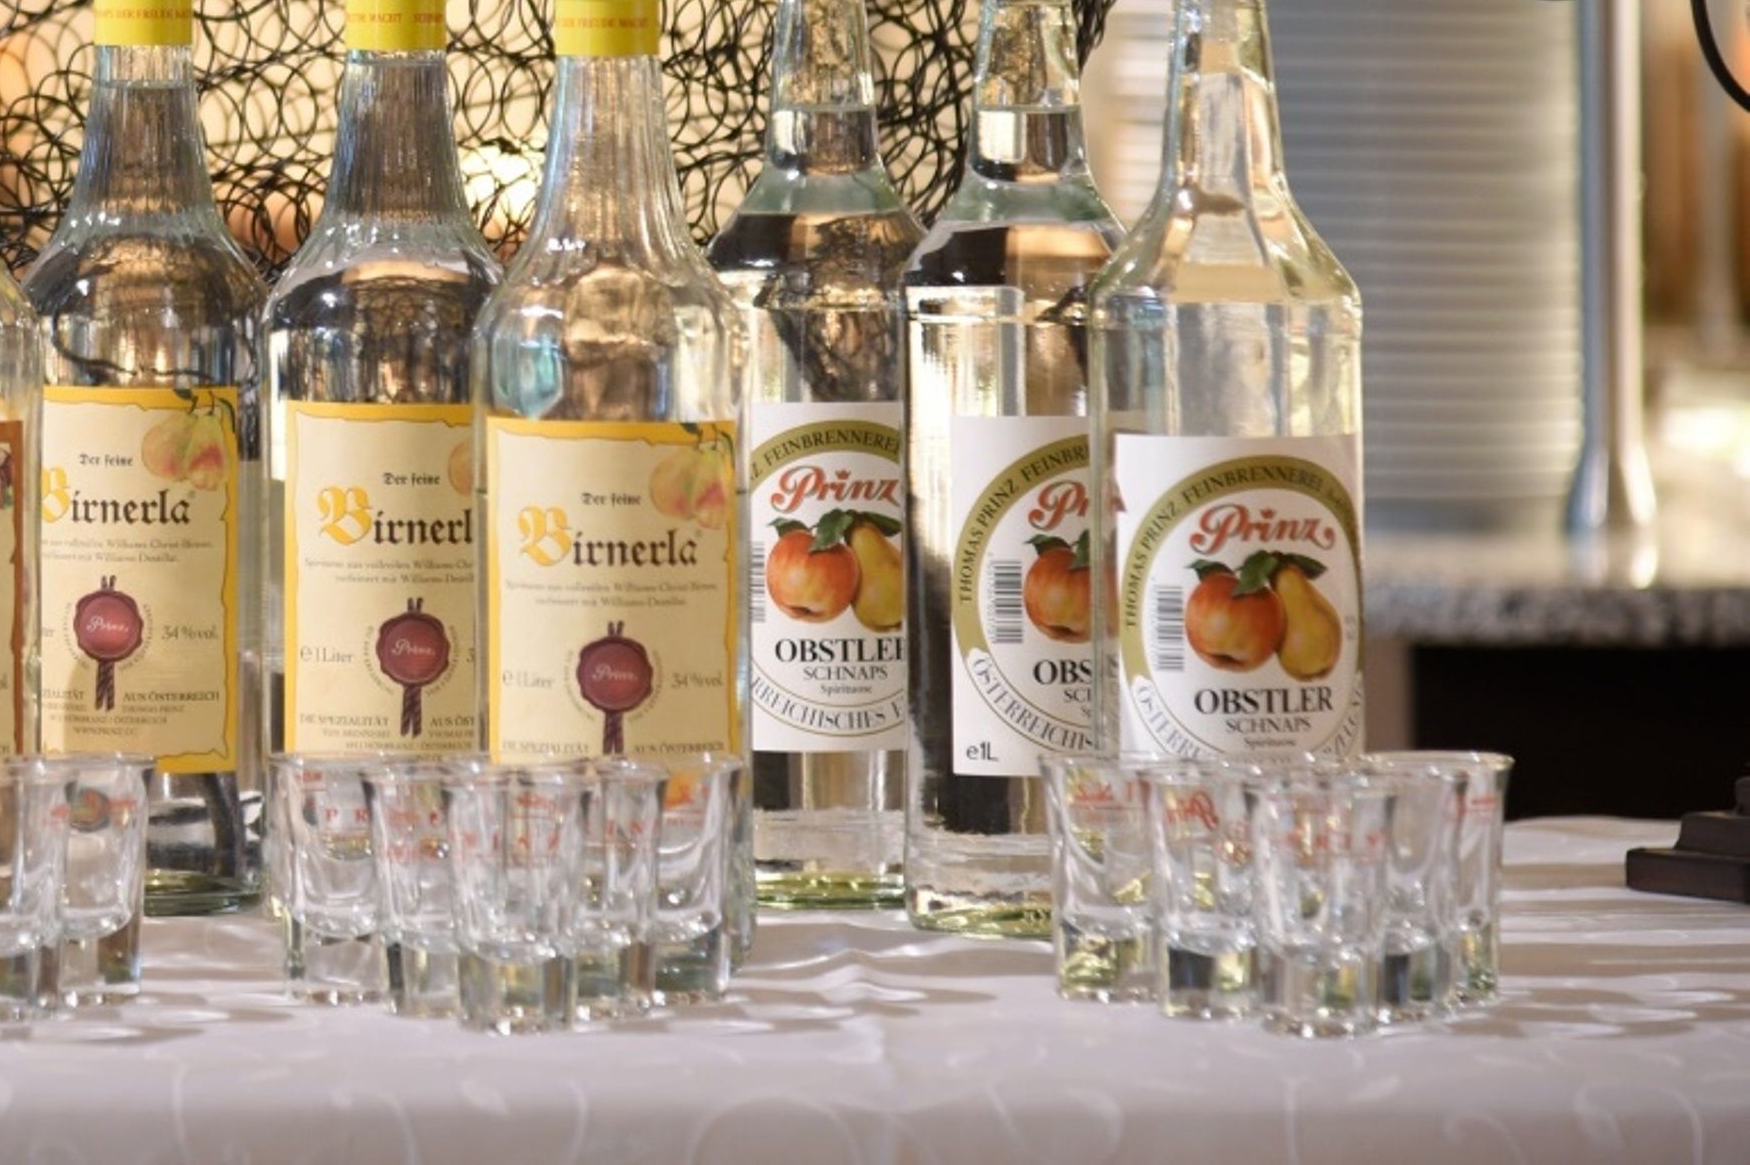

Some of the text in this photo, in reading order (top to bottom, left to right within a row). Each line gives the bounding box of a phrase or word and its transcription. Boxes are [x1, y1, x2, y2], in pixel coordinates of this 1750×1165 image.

[770, 465, 901, 514] Prinz
[517, 506, 698, 568] Birnerla
[959, 527, 985, 605] THOMAS
[975, 479, 1019, 528] PRINZ
[1125, 552, 1147, 627] THOMAS
[1138, 500, 1178, 551] PRINZ
[1182, 464, 1323, 505] FEINBRENNEREI
[1189, 502, 1336, 556] Prinz
[323, 647, 354, 664] Liter
[803, 664, 888, 681] SCHNAPS
[1194, 686, 1334, 715] OBSTLER
[1226, 716, 1312, 734] SCHNAPS
